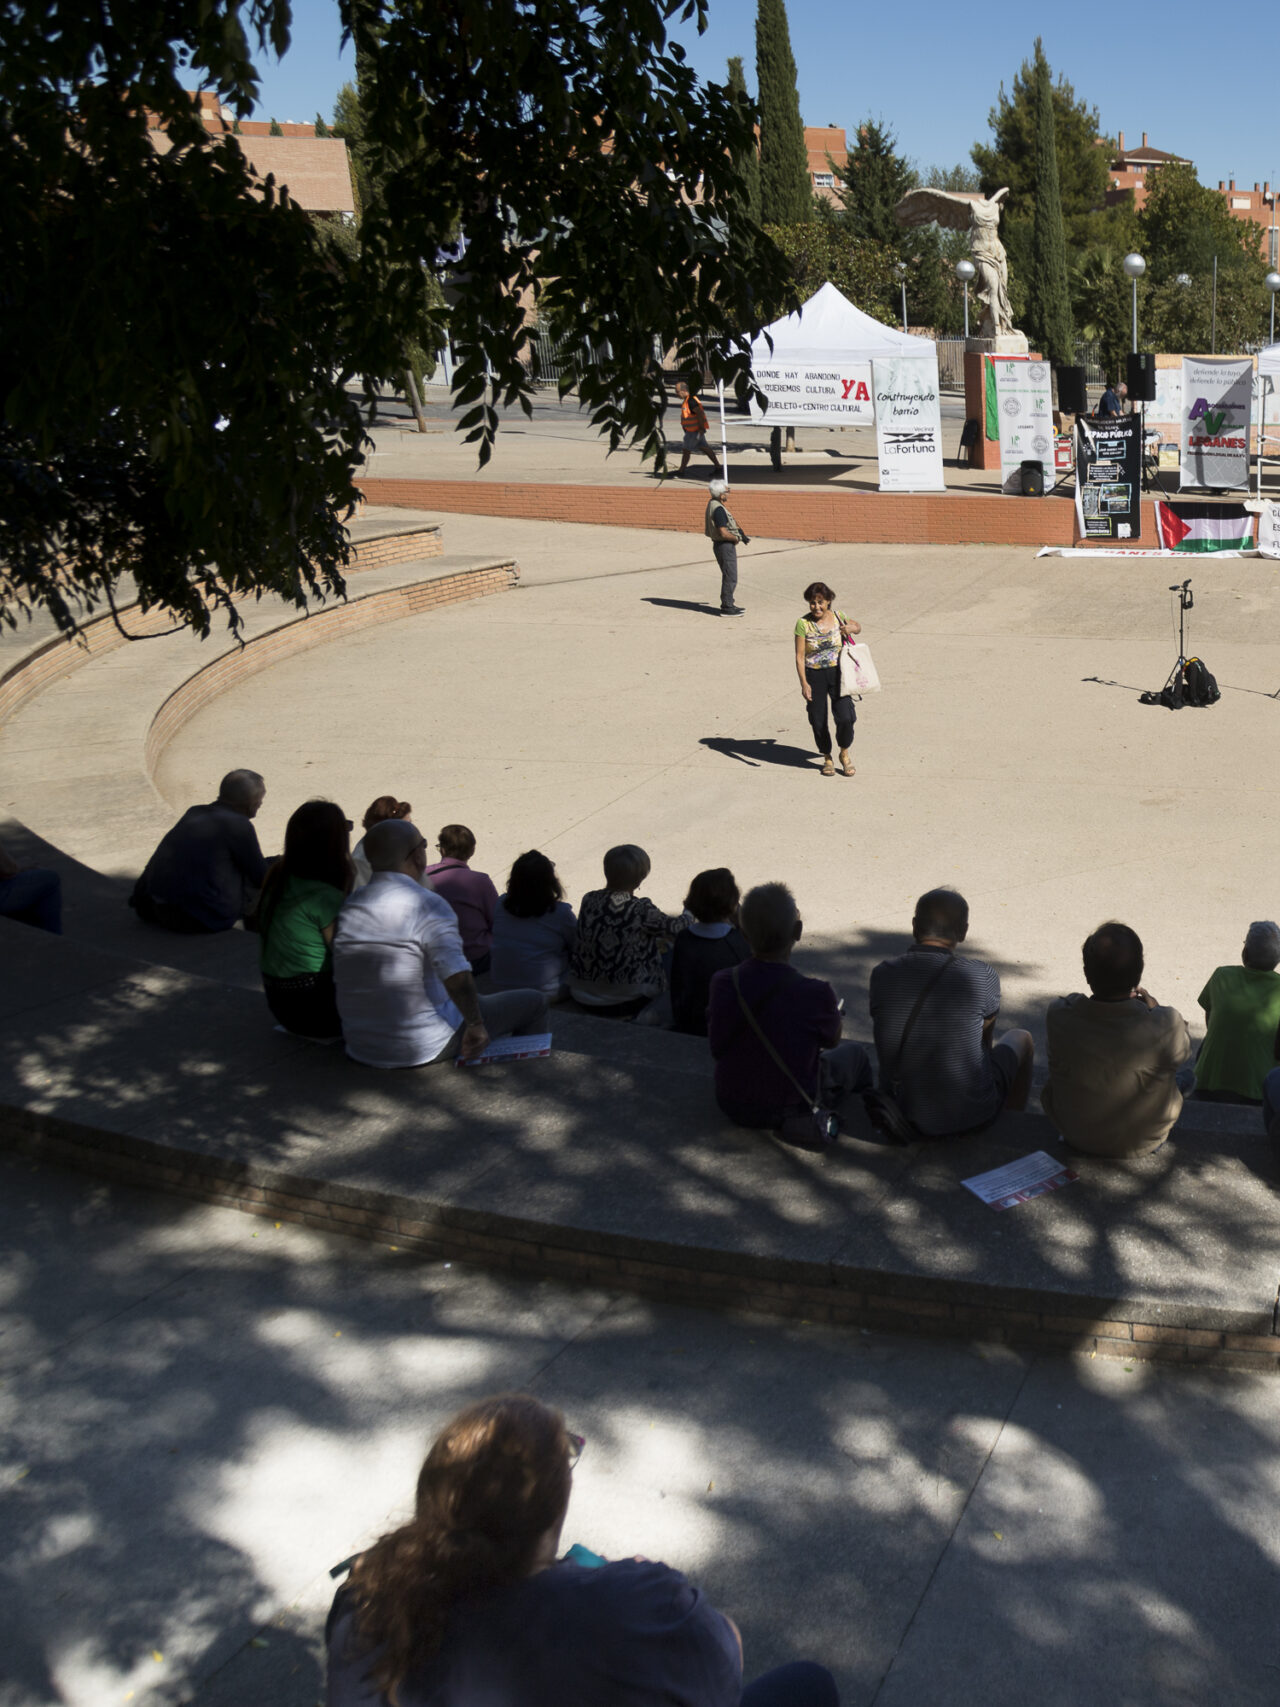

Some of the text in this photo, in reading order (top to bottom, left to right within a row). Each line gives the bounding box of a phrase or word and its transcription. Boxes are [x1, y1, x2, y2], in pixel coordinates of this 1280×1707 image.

[765, 384, 835, 394] QUEREMOS CULTURA
[841, 379, 870, 401] YA
[877, 392, 935, 405] Construyendo
[803, 403, 829, 411] CENTRO
[830, 404, 862, 412] CULTURAL
[893, 406, 919, 415] barrio
[1188, 436, 1246, 449] LEGANES
